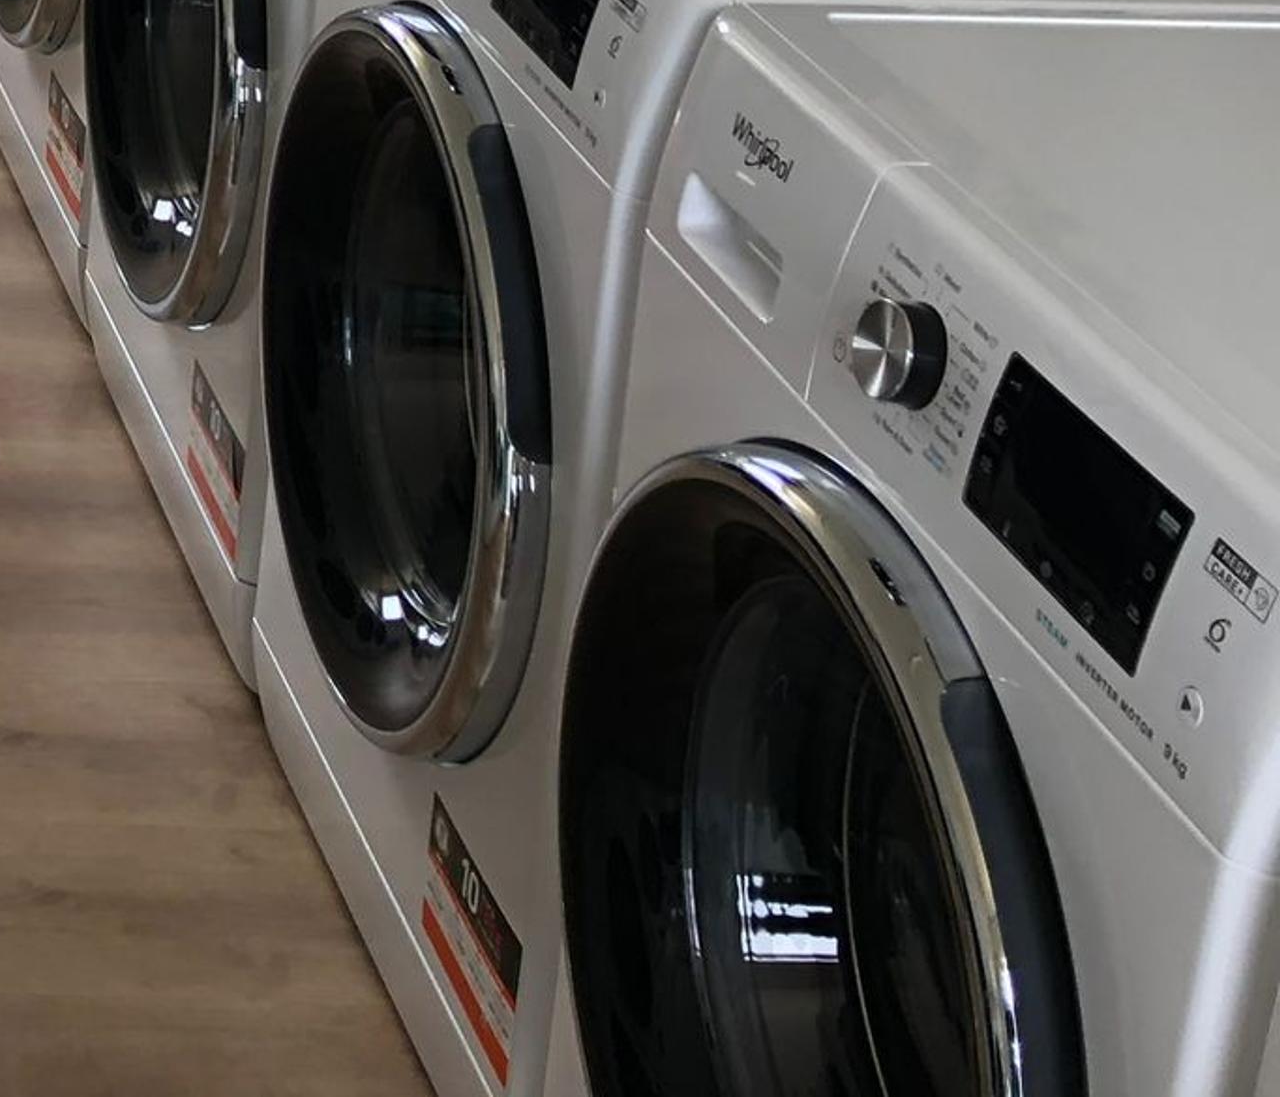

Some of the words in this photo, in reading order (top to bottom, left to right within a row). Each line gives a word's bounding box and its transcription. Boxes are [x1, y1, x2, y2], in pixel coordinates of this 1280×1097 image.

[732, 112, 794, 183] Whirlpool
[1214, 544, 1253, 583] FRESH
[1120, 699, 1154, 740] MOTOR
[462, 858, 480, 915] 10
